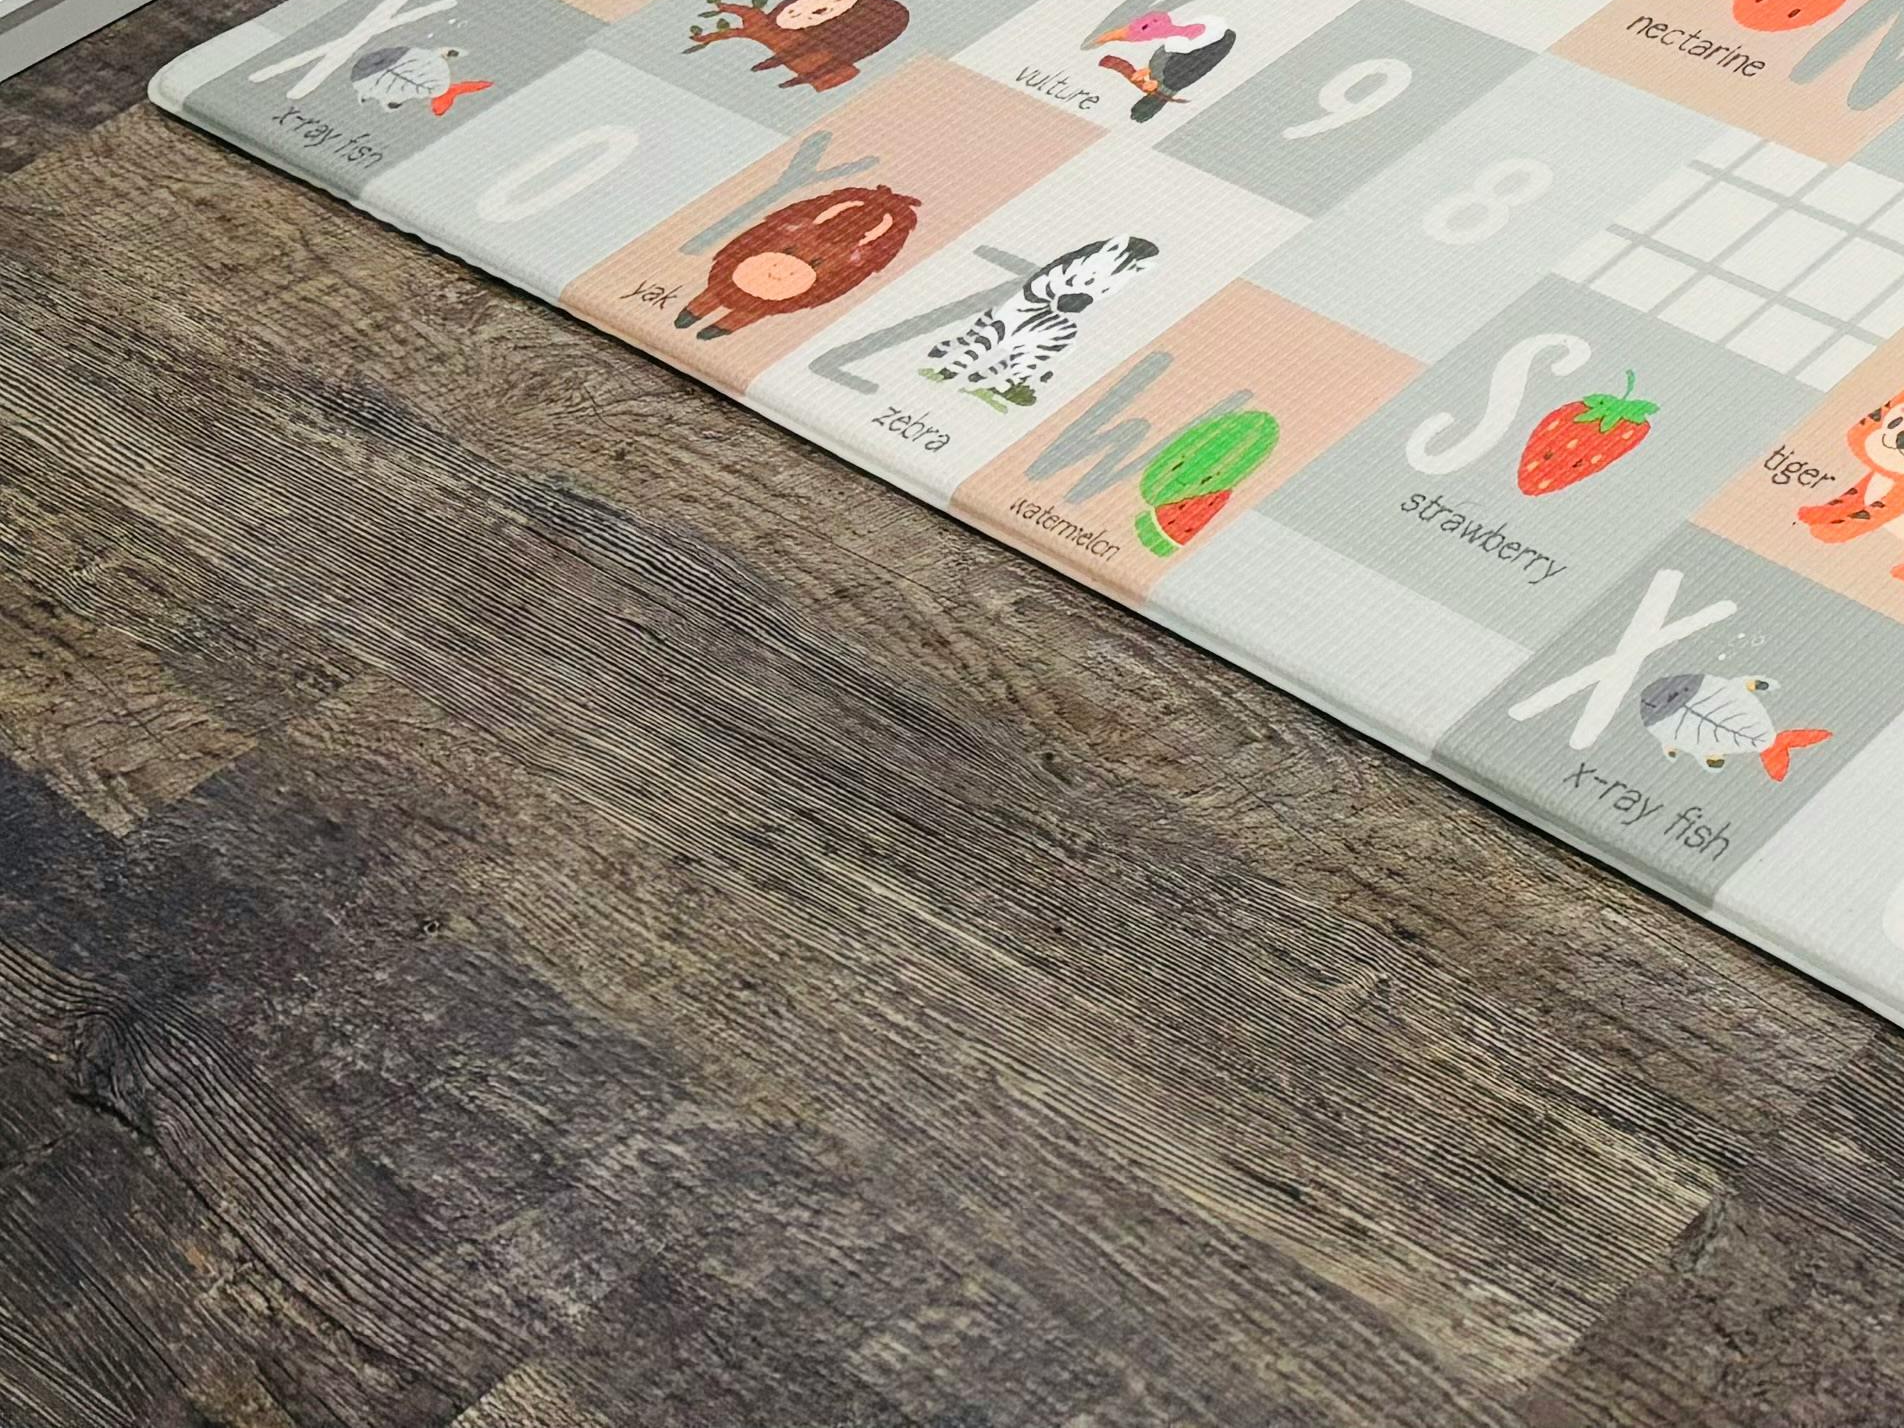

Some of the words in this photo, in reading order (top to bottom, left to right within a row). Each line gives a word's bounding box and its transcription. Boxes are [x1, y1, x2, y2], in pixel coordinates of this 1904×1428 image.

[1013, 62, 1103, 113] vulture
[1624, 7, 1770, 82] nectarine
[1283, 56, 1414, 140] 9
[678, 129, 881, 258] Y
[1421, 157, 1555, 246] 8
[620, 278, 680, 311] yak
[871, 402, 953, 457] zebra
[1405, 331, 1593, 478] S
[1760, 442, 1838, 493] tiger
[1399, 485, 1568, 587] strawberry
[1507, 566, 1739, 752] X
[1562, 758, 1665, 832] x-ray
[1668, 800, 1737, 866] fish
